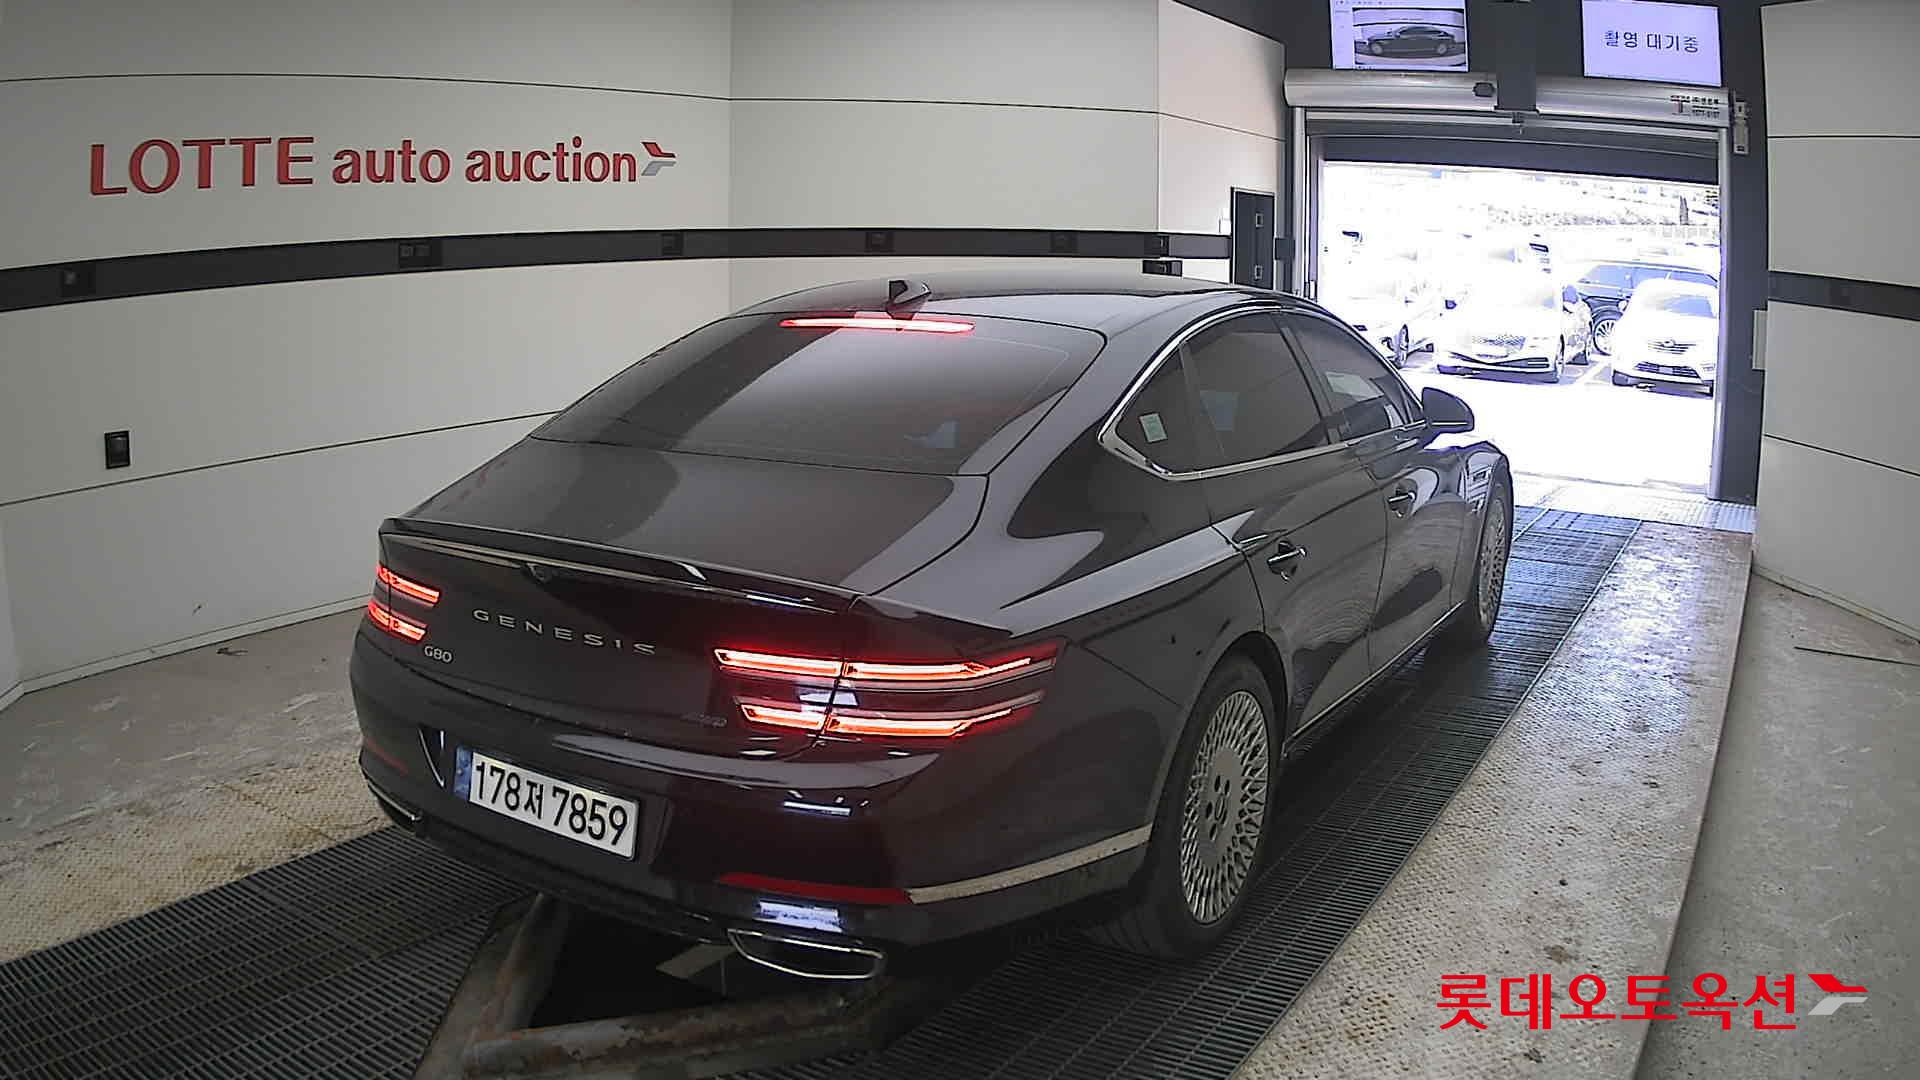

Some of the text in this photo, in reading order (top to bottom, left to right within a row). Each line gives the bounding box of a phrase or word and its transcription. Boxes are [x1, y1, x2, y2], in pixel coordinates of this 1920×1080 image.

[1646, 33, 1699, 53] 대기중
[91, 135, 637, 196] LOTTE auto auction
[423, 645, 453, 664] G80
[473, 609, 656, 655] GENESIS
[476, 761, 628, 846] 178저 7859
